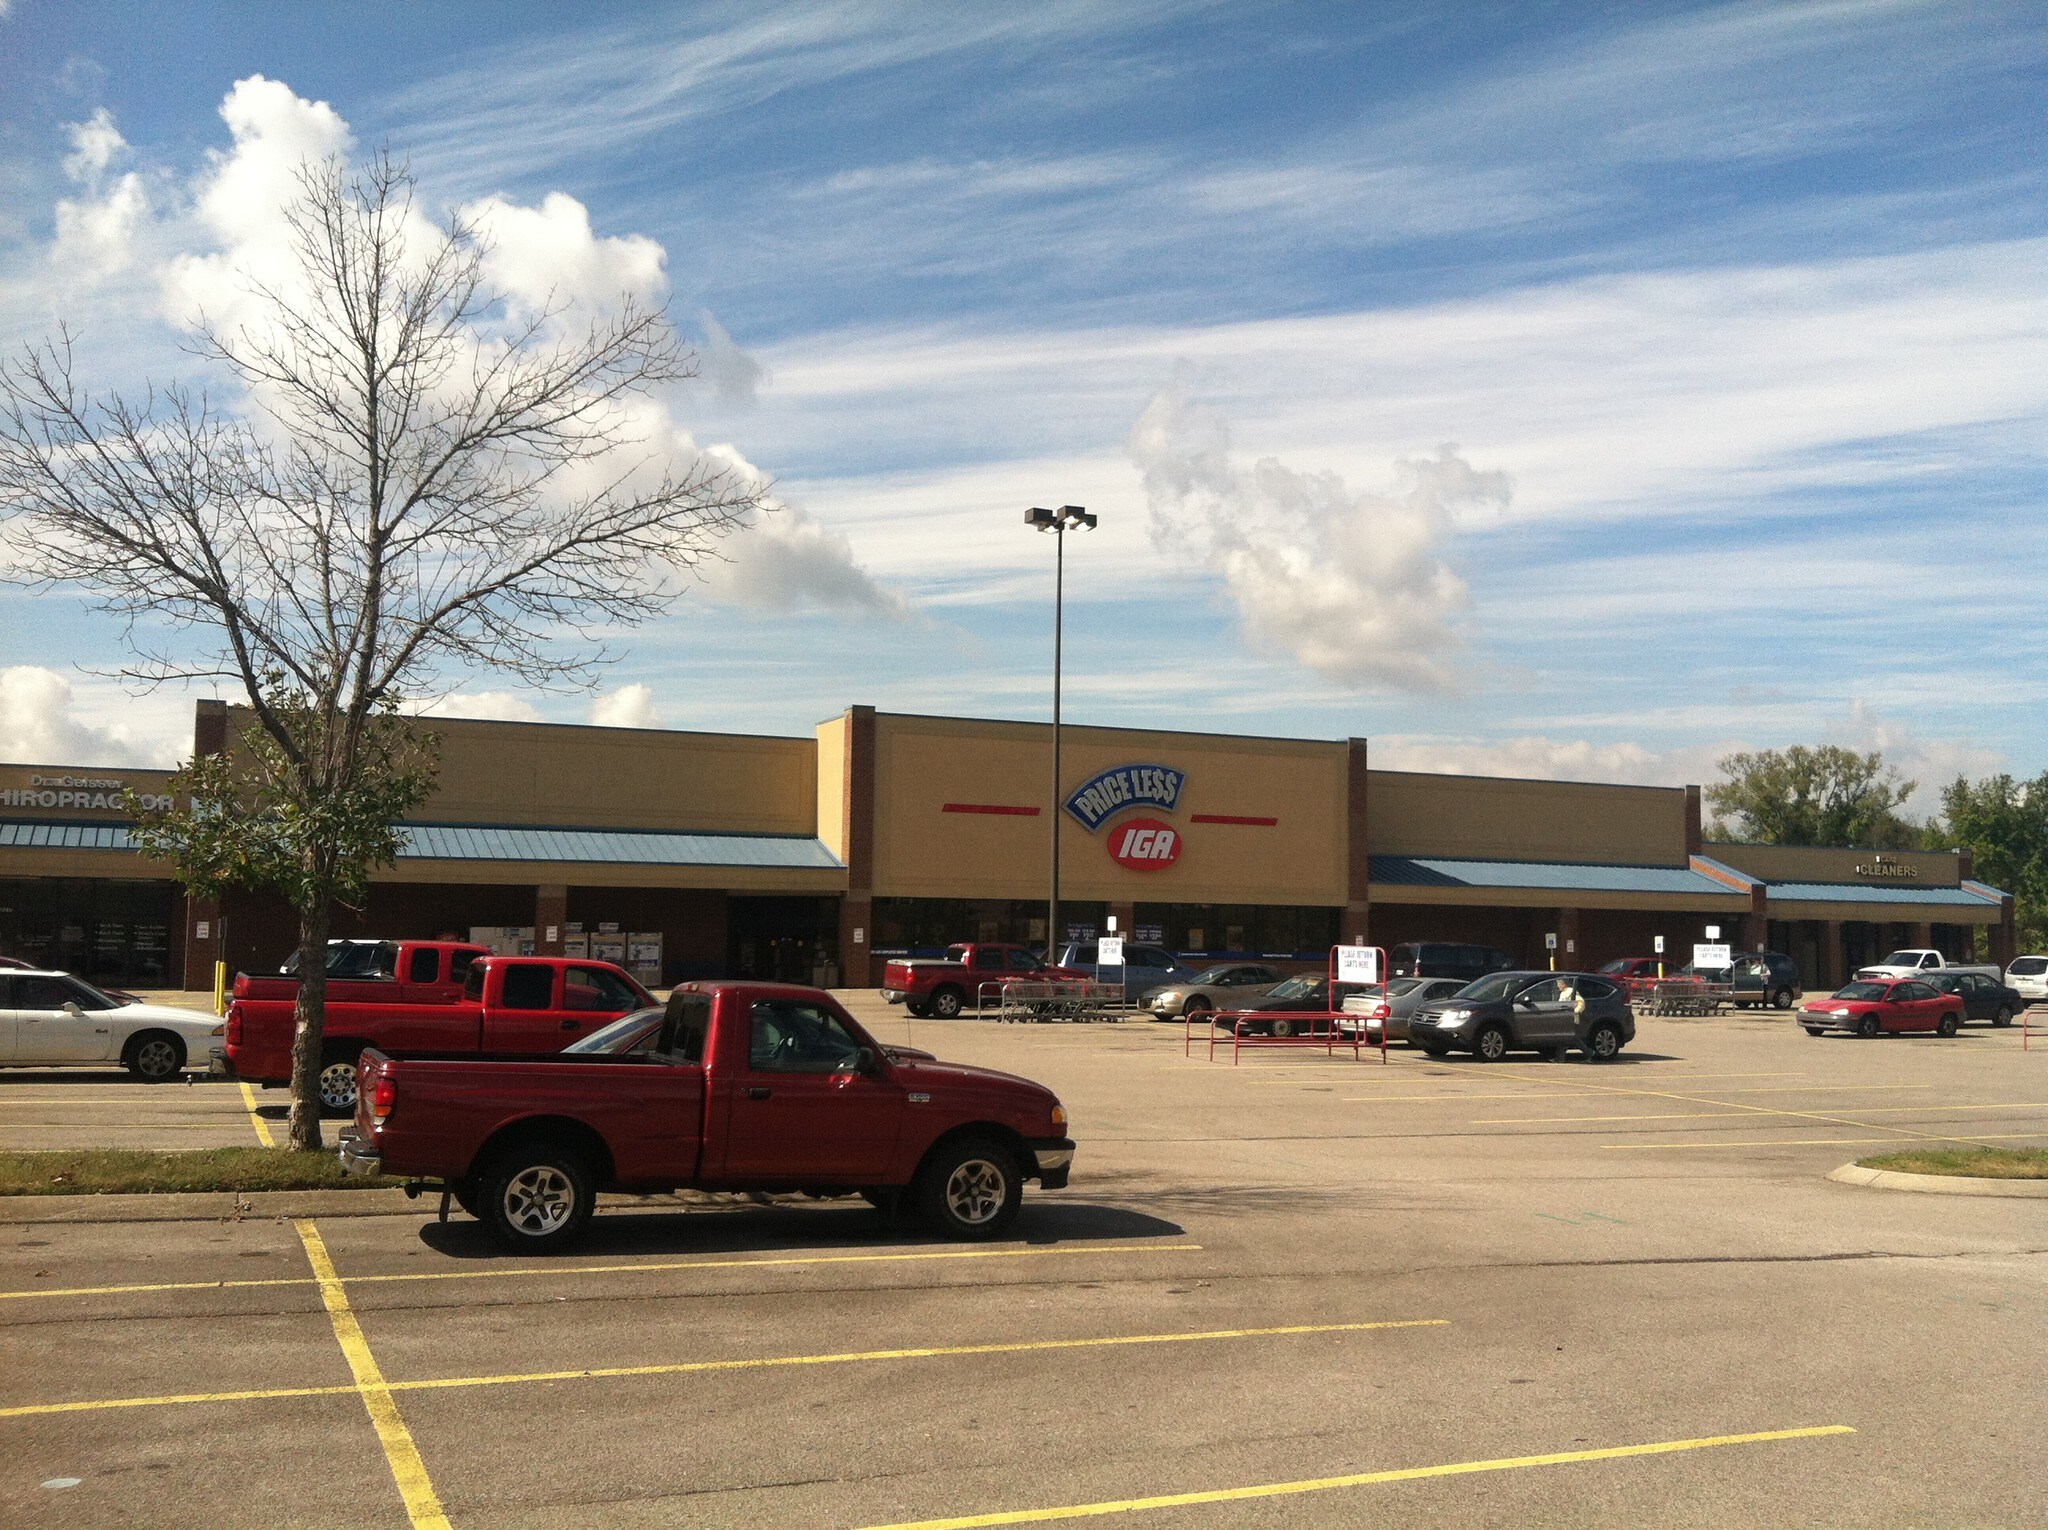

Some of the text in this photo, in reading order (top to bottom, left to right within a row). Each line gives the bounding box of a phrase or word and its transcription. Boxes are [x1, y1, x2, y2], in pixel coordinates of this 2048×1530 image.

[1074, 771, 1132, 823] PRICE
[1118, 828, 1176, 860] IGA
[1859, 863, 1919, 877] CLEANERS
